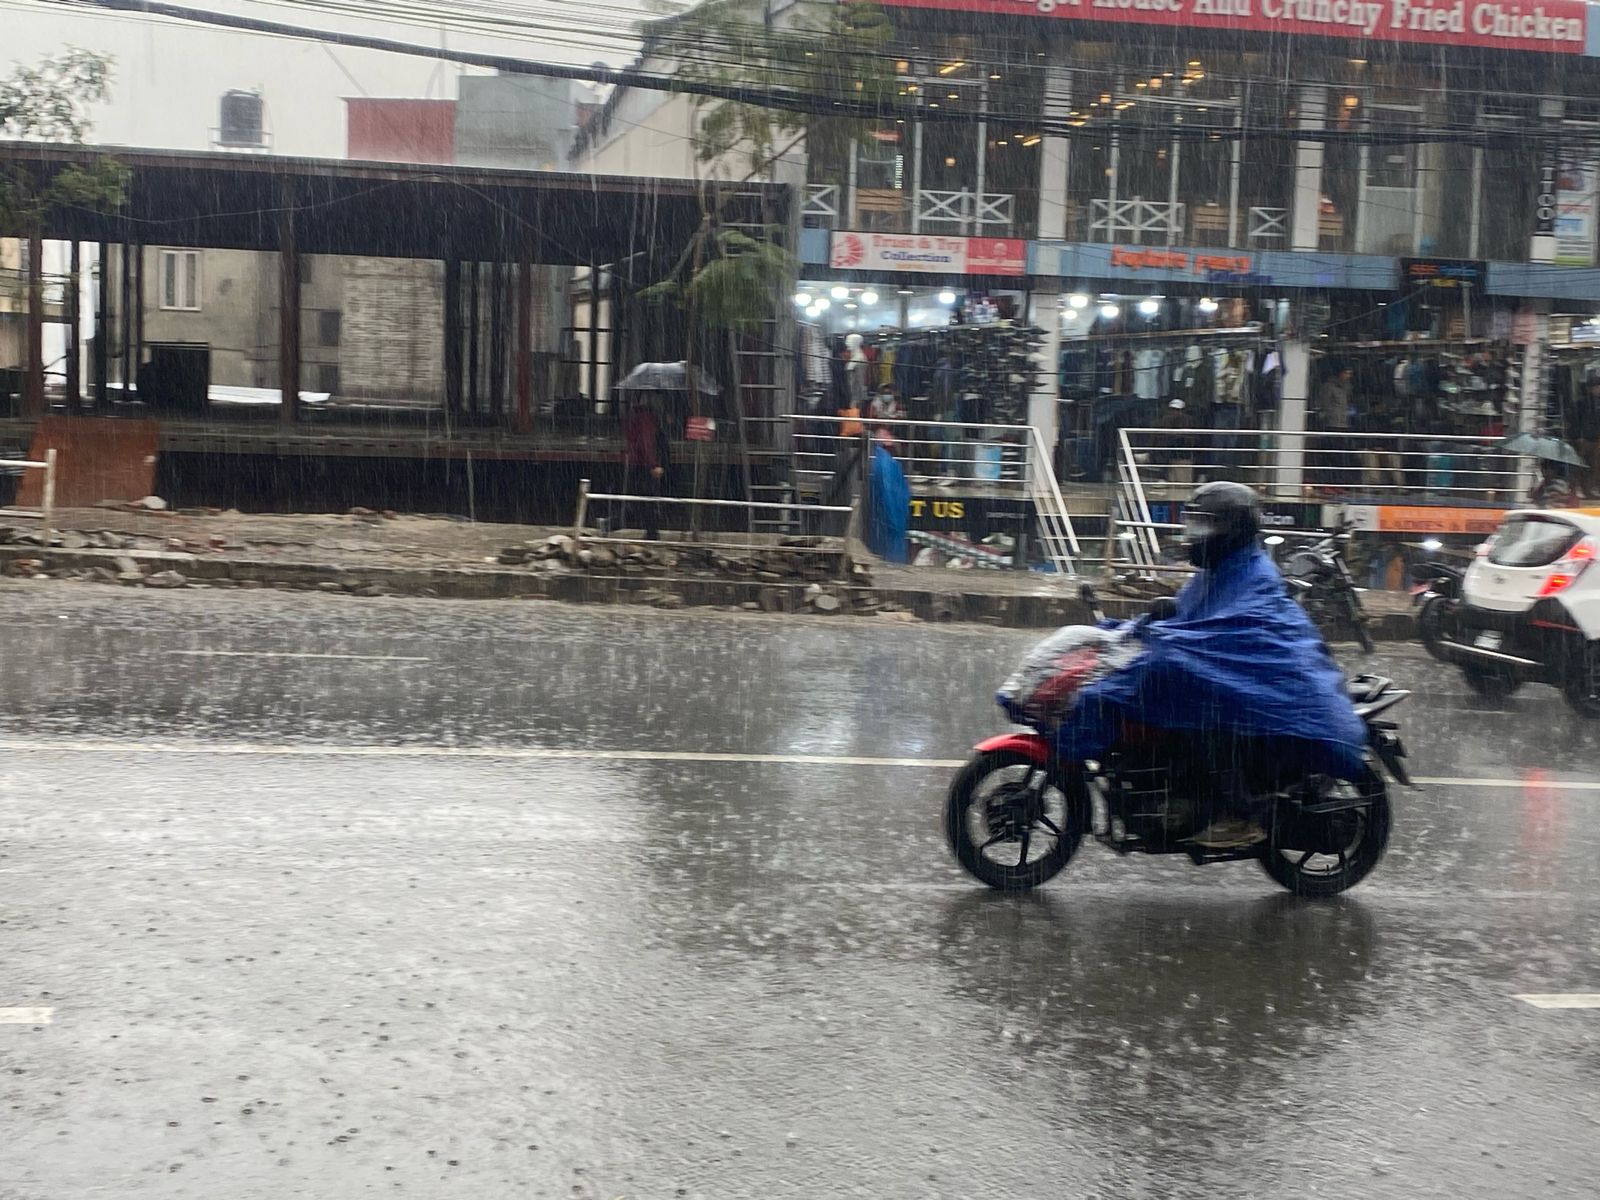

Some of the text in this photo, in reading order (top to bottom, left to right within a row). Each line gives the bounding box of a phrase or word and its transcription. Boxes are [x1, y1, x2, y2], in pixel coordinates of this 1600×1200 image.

[1260, 0, 1384, 35] Crunchy
[1391, 0, 1465, 33] Fried
[1471, 3, 1585, 41] Chicken
[932, 501, 965, 518] US
